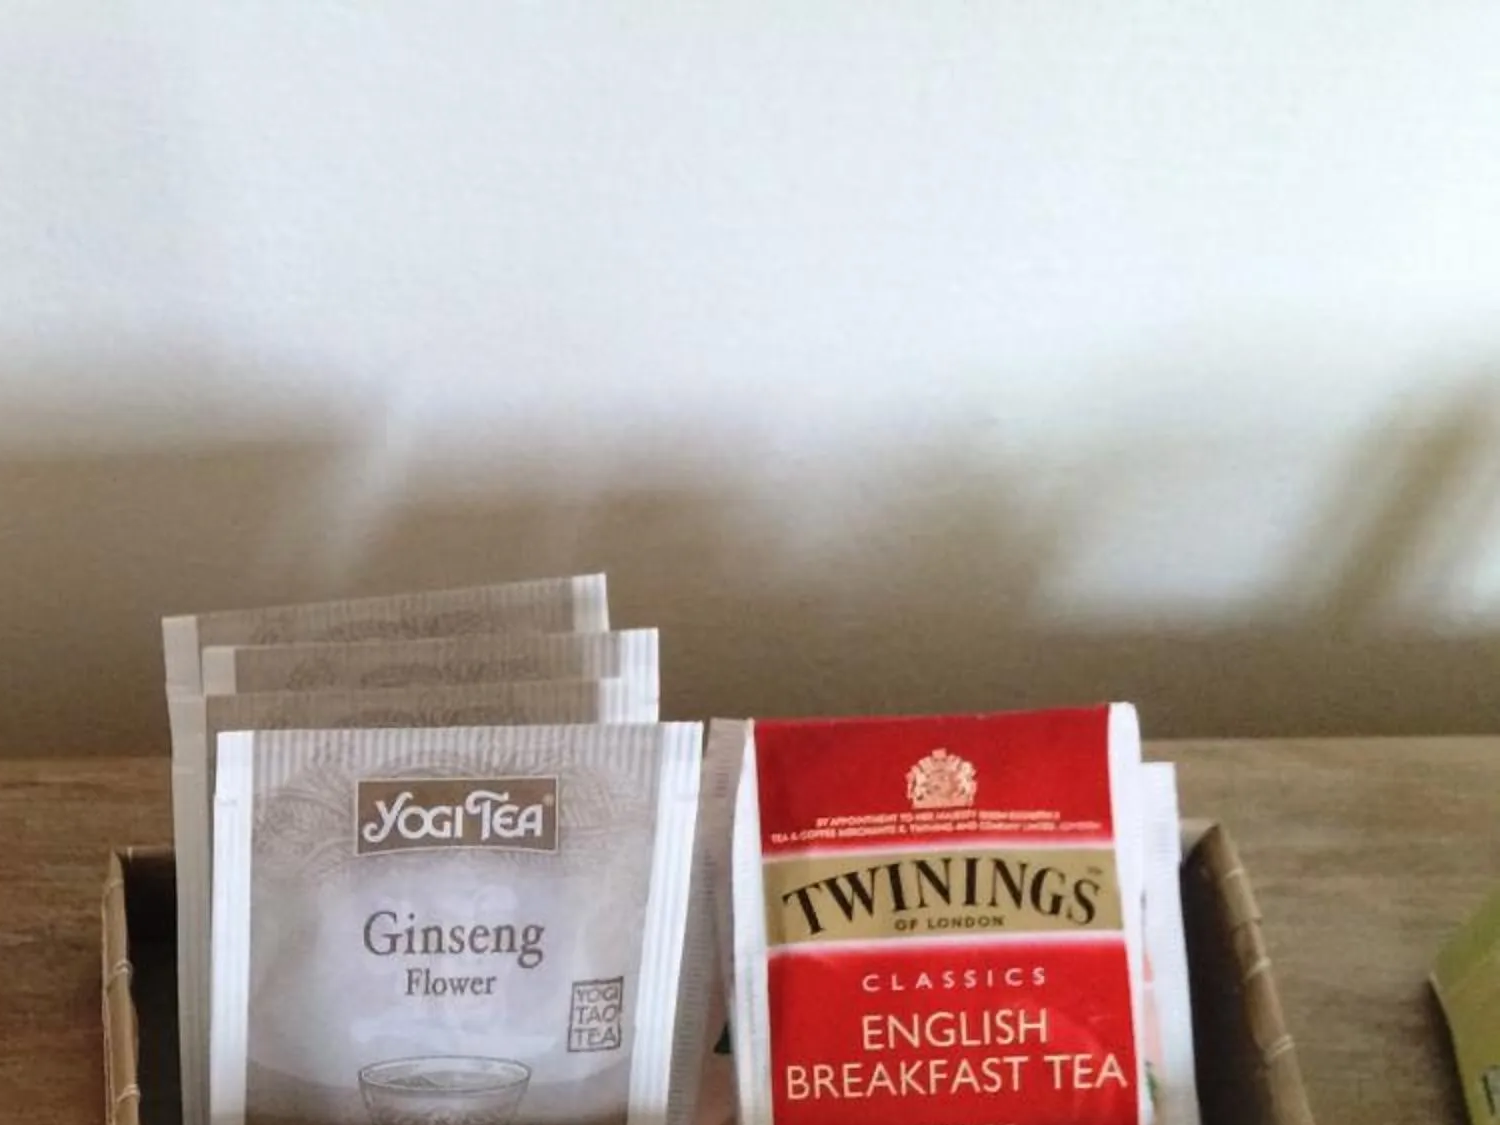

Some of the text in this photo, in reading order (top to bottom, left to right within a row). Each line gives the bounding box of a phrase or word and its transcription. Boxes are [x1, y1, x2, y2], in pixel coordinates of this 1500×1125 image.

[782, 856, 1101, 936] TWININGS
[362, 909, 546, 969] Ginseng
[894, 915, 1005, 931] OF LONDON
[404, 967, 498, 997] Flower
[861, 967, 1047, 993] CLASSICS
[861, 1008, 1049, 1051] ENGLISH
[786, 1052, 1129, 1101] BREAKFAST TEA
